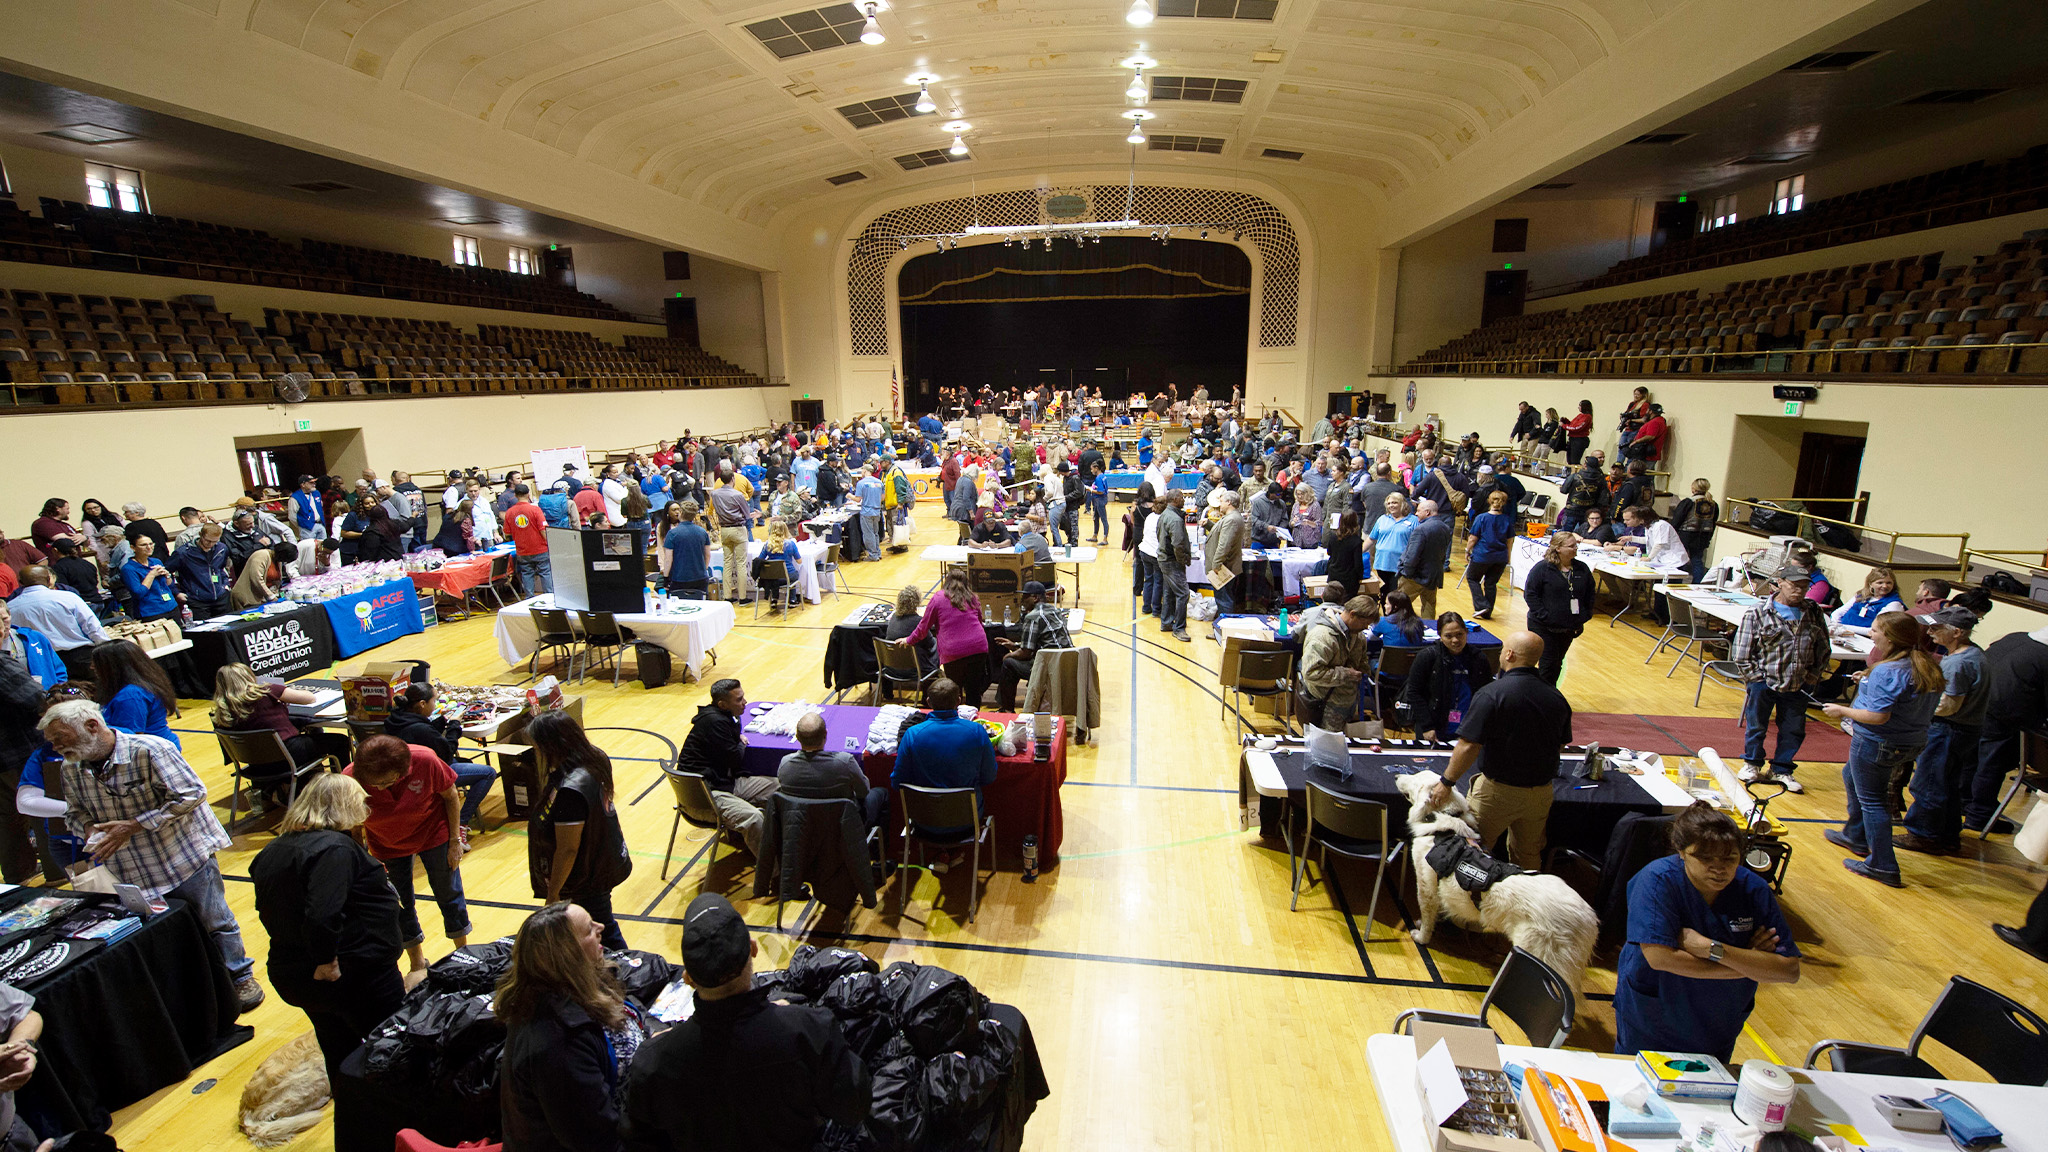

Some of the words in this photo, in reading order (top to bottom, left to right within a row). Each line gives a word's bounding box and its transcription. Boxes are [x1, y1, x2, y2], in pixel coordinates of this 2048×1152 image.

[1782, 389, 1806, 398] ATM
[1784, 402, 1799, 415] EXIT
[366, 590, 405, 610] AFGE
[243, 624, 284, 646] NAVY
[247, 630, 310, 657] FEDERAL
[250, 654, 282, 671] Credit
[282, 646, 312, 661] Union
[1460, 863, 1477, 876] SERVICE
[1476, 872, 1487, 881] DOG
